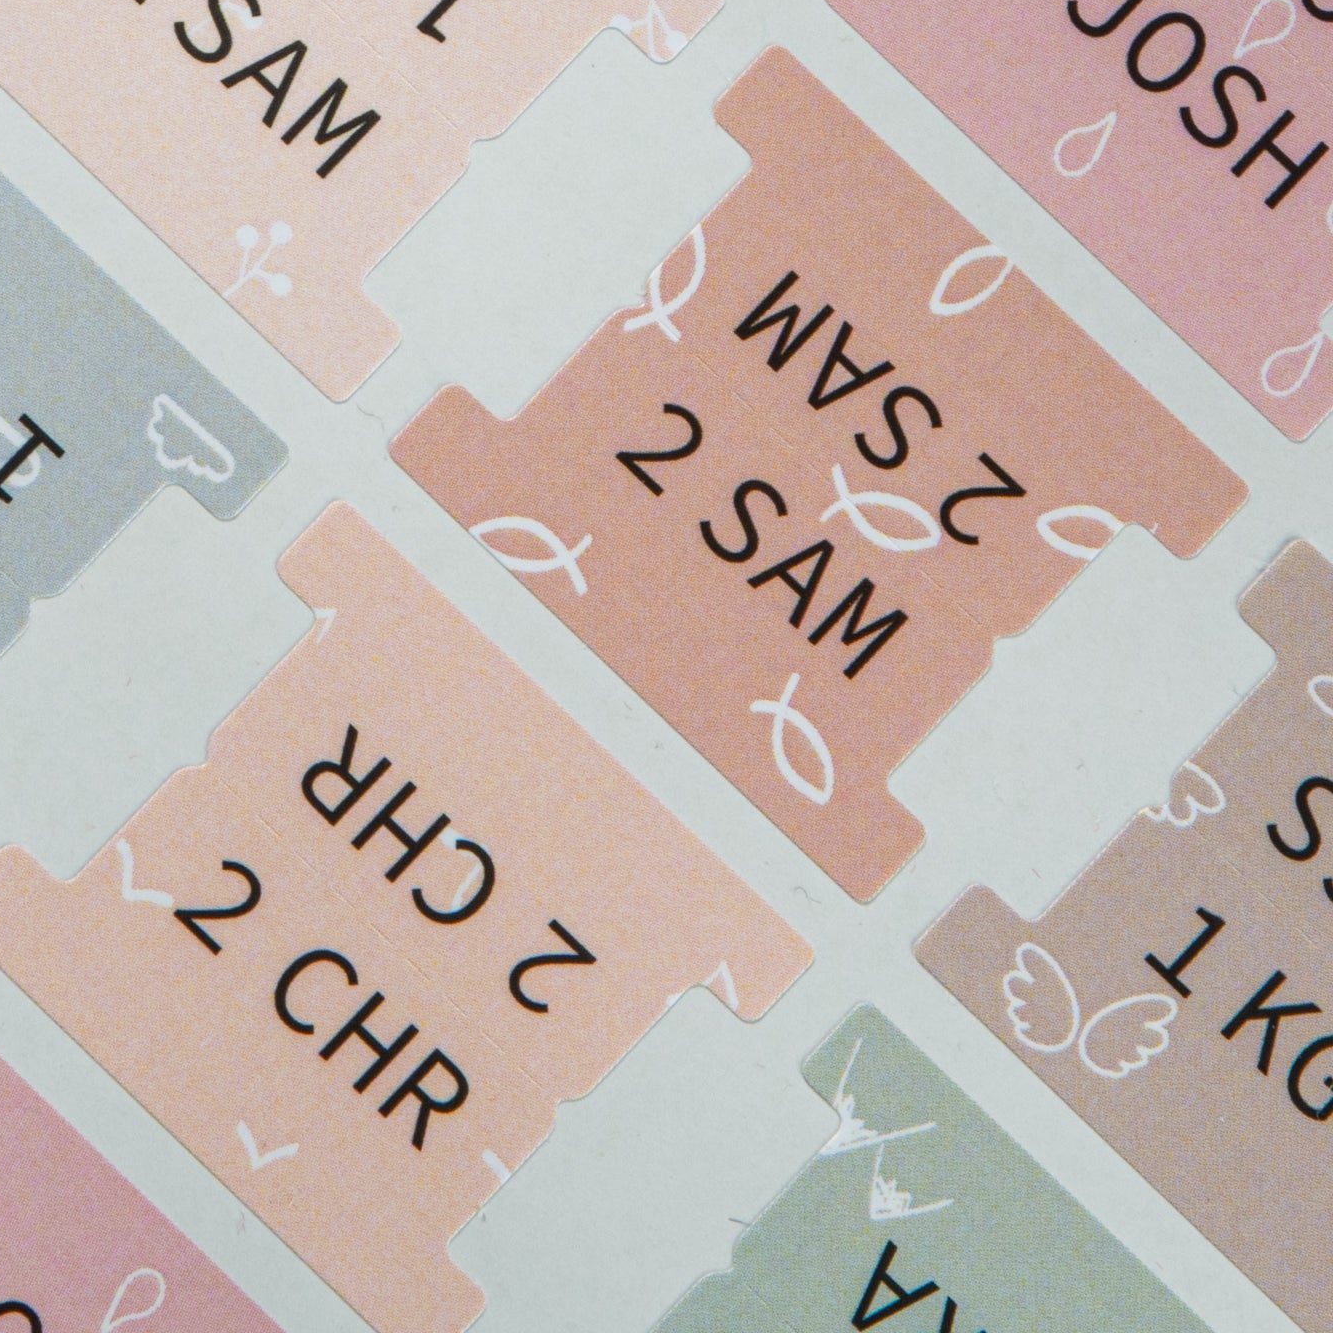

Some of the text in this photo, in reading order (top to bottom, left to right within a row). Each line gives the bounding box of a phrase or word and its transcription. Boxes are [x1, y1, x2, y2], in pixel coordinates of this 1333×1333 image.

[615, 403, 909, 680] 2 SAM
[733, 270, 1027, 546] 2 SAM
[173, 860, 469, 1151] 2 CHR
[301, 724, 597, 1014] 2 CHR
[1144, 907, 1226, 999] 1
